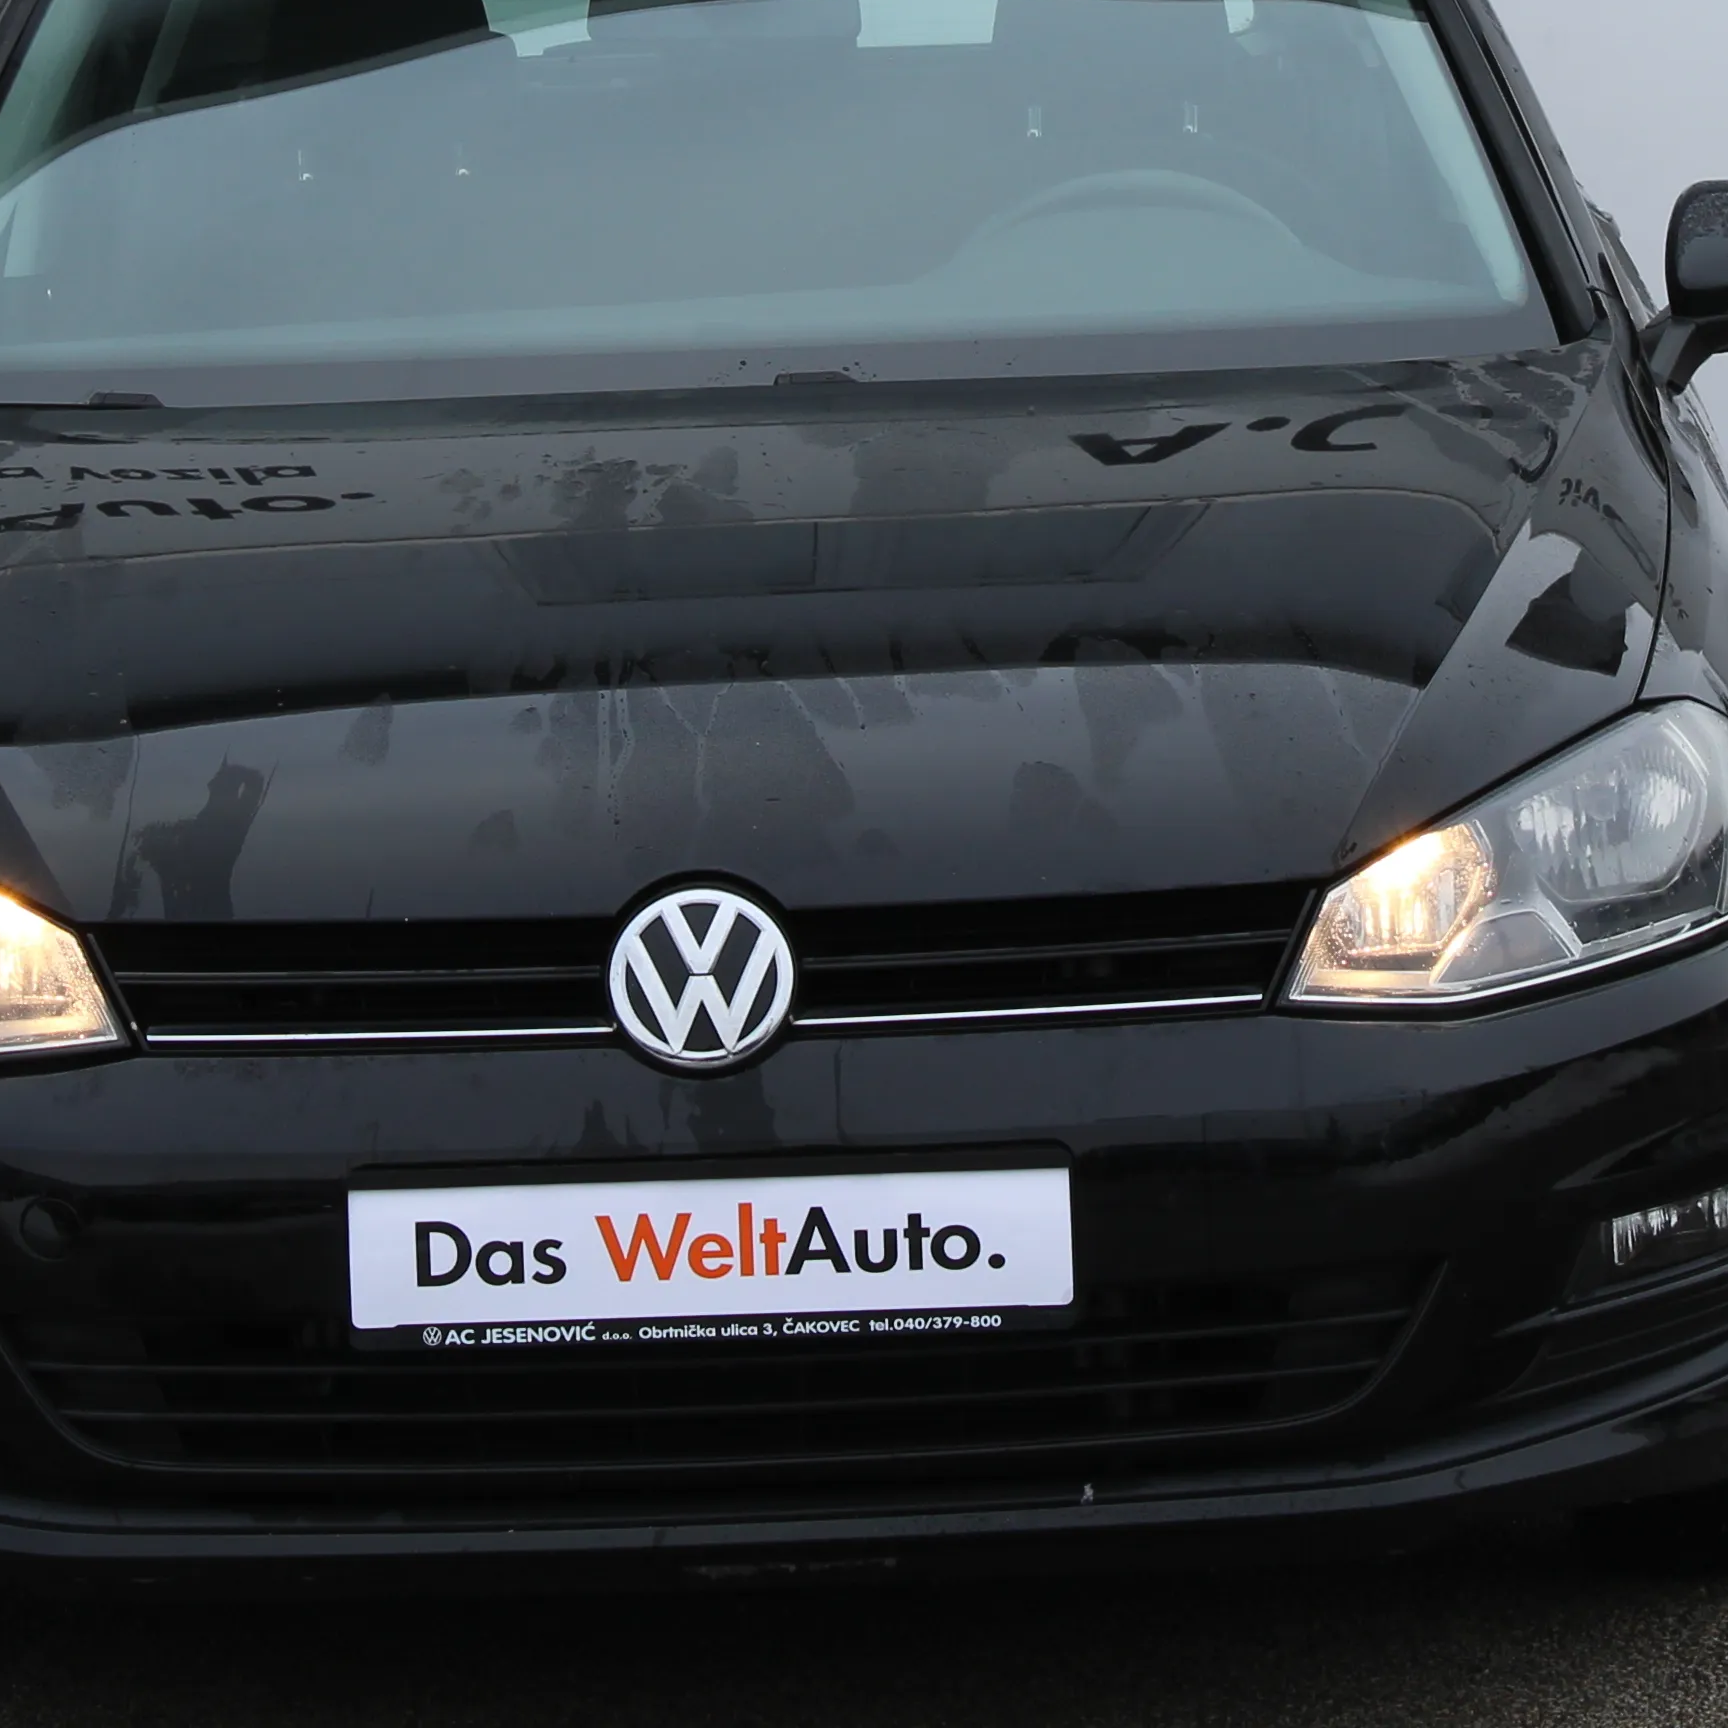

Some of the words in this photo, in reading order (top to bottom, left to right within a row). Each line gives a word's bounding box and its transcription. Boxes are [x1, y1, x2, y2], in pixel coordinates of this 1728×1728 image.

[414, 1220, 567, 1288] Das
[594, 1202, 1006, 1283] WeltAuto.
[444, 1328, 476, 1346] AC
[480, 1321, 597, 1344] JESENOVIĆ
[601, 1330, 633, 1342] d.o.o.
[638, 1324, 717, 1340] Obrtnička
[720, 1322, 758, 1338] ulica
[762, 1322, 778, 1338] 3,
[782, 1317, 861, 1335] ČAKOVEC
